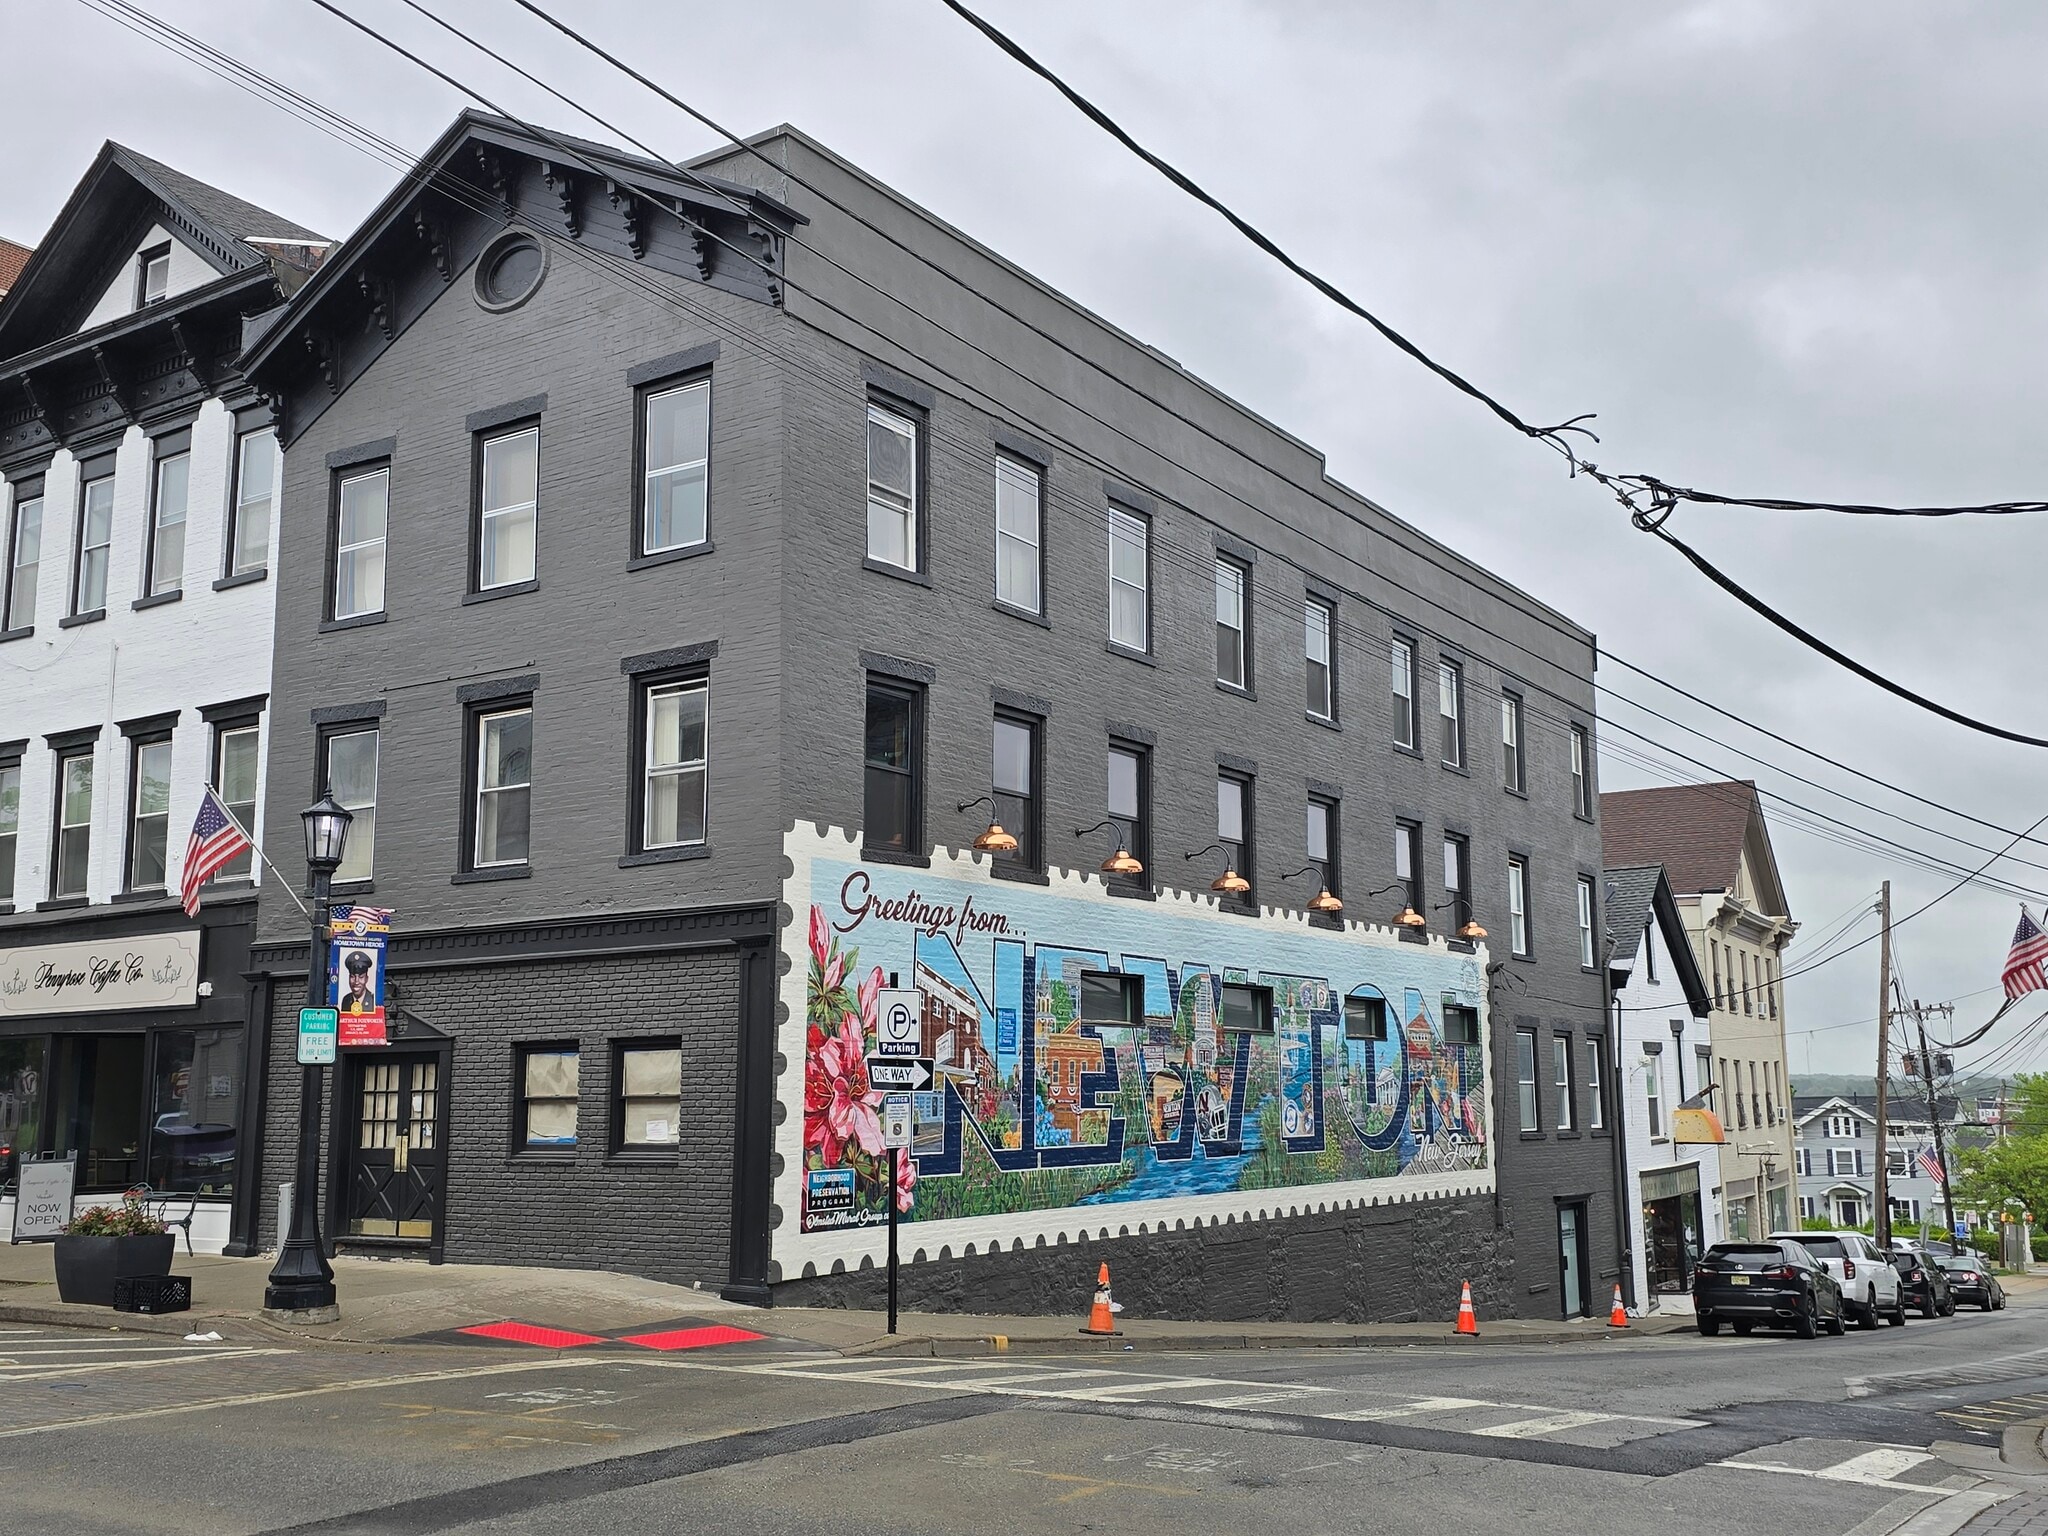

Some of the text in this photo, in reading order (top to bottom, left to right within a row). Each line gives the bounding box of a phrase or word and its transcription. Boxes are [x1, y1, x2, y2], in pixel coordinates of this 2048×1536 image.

[832, 871, 957, 938] Greetings
[34, 952, 144, 996] Pennyrose Coffee Co.
[303, 1012, 334, 1021] CUSTOMER
[305, 1022, 331, 1031] PARKING
[306, 1036, 329, 1046] FREE
[882, 1043, 916, 1054] Parking
[912, 927, 1477, 1178] NEWTON
[873, 1068, 912, 1081] ONE WAY
[1415, 1132, 1482, 1168] New Jersey
[812, 1173, 850, 1183] NEIGHBORHOOD
[811, 1187, 850, 1198] PRESERVATION
[27, 1203, 61, 1213] NOW
[811, 1199, 850, 1207] PROGRAM
[23, 1215, 62, 1225] OPEN
